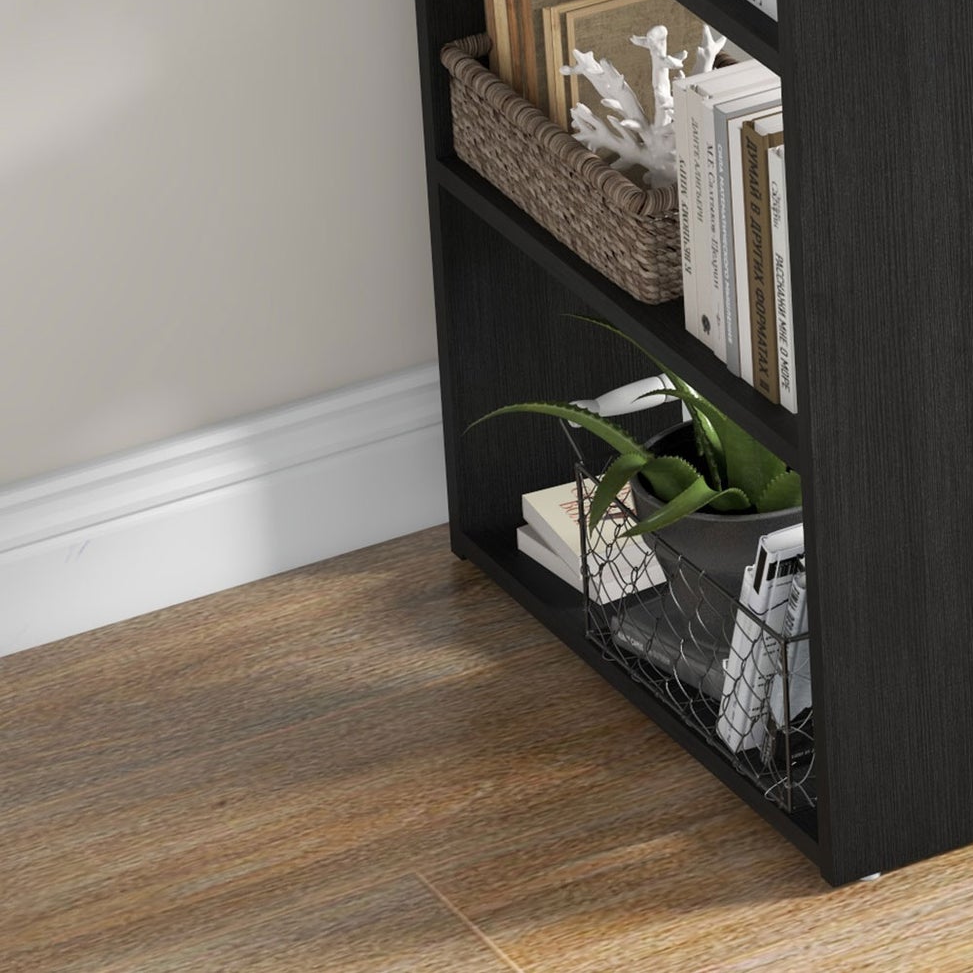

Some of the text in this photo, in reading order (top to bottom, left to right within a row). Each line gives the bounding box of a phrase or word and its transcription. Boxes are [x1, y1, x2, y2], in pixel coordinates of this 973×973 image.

[747, 136, 769, 377] ДУМАЙ В ДРУГИХ ФОРМАТАХ
[775, 253, 787, 318] РАССКАЖИ
[779, 318, 788, 344] МНЕ
[780, 357, 790, 392] МОРЕ
